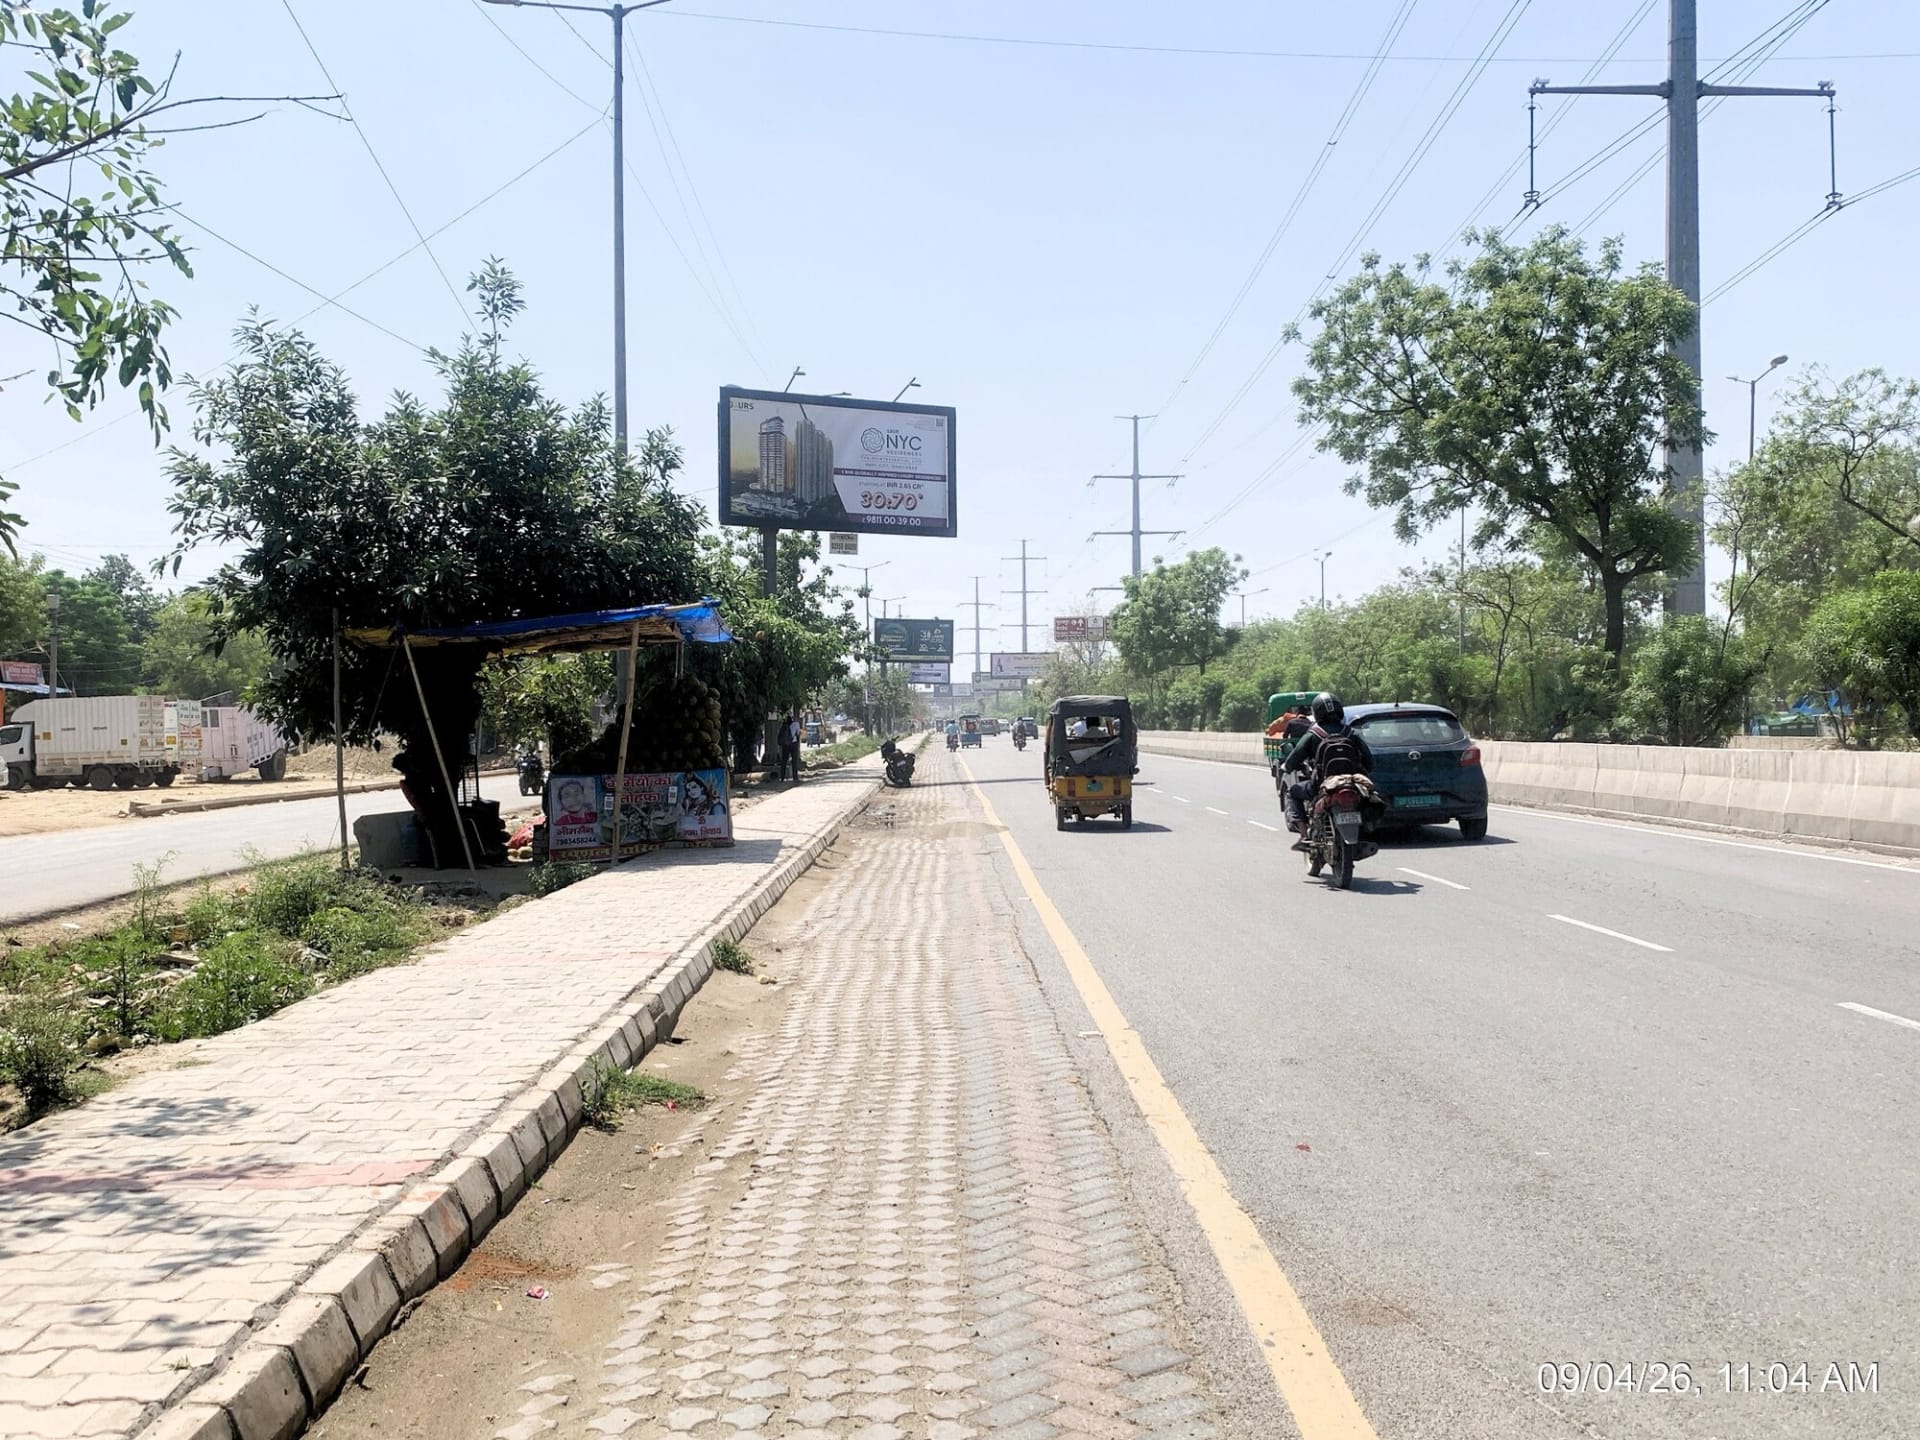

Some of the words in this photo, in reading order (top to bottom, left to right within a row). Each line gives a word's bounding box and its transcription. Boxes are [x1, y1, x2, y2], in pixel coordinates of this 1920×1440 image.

[886, 434, 922, 451] NYC
[866, 515, 882, 524] 9811
[883, 516, 896, 525] 00
[897, 516, 908, 526] 39
[909, 517, 921, 526] 00
